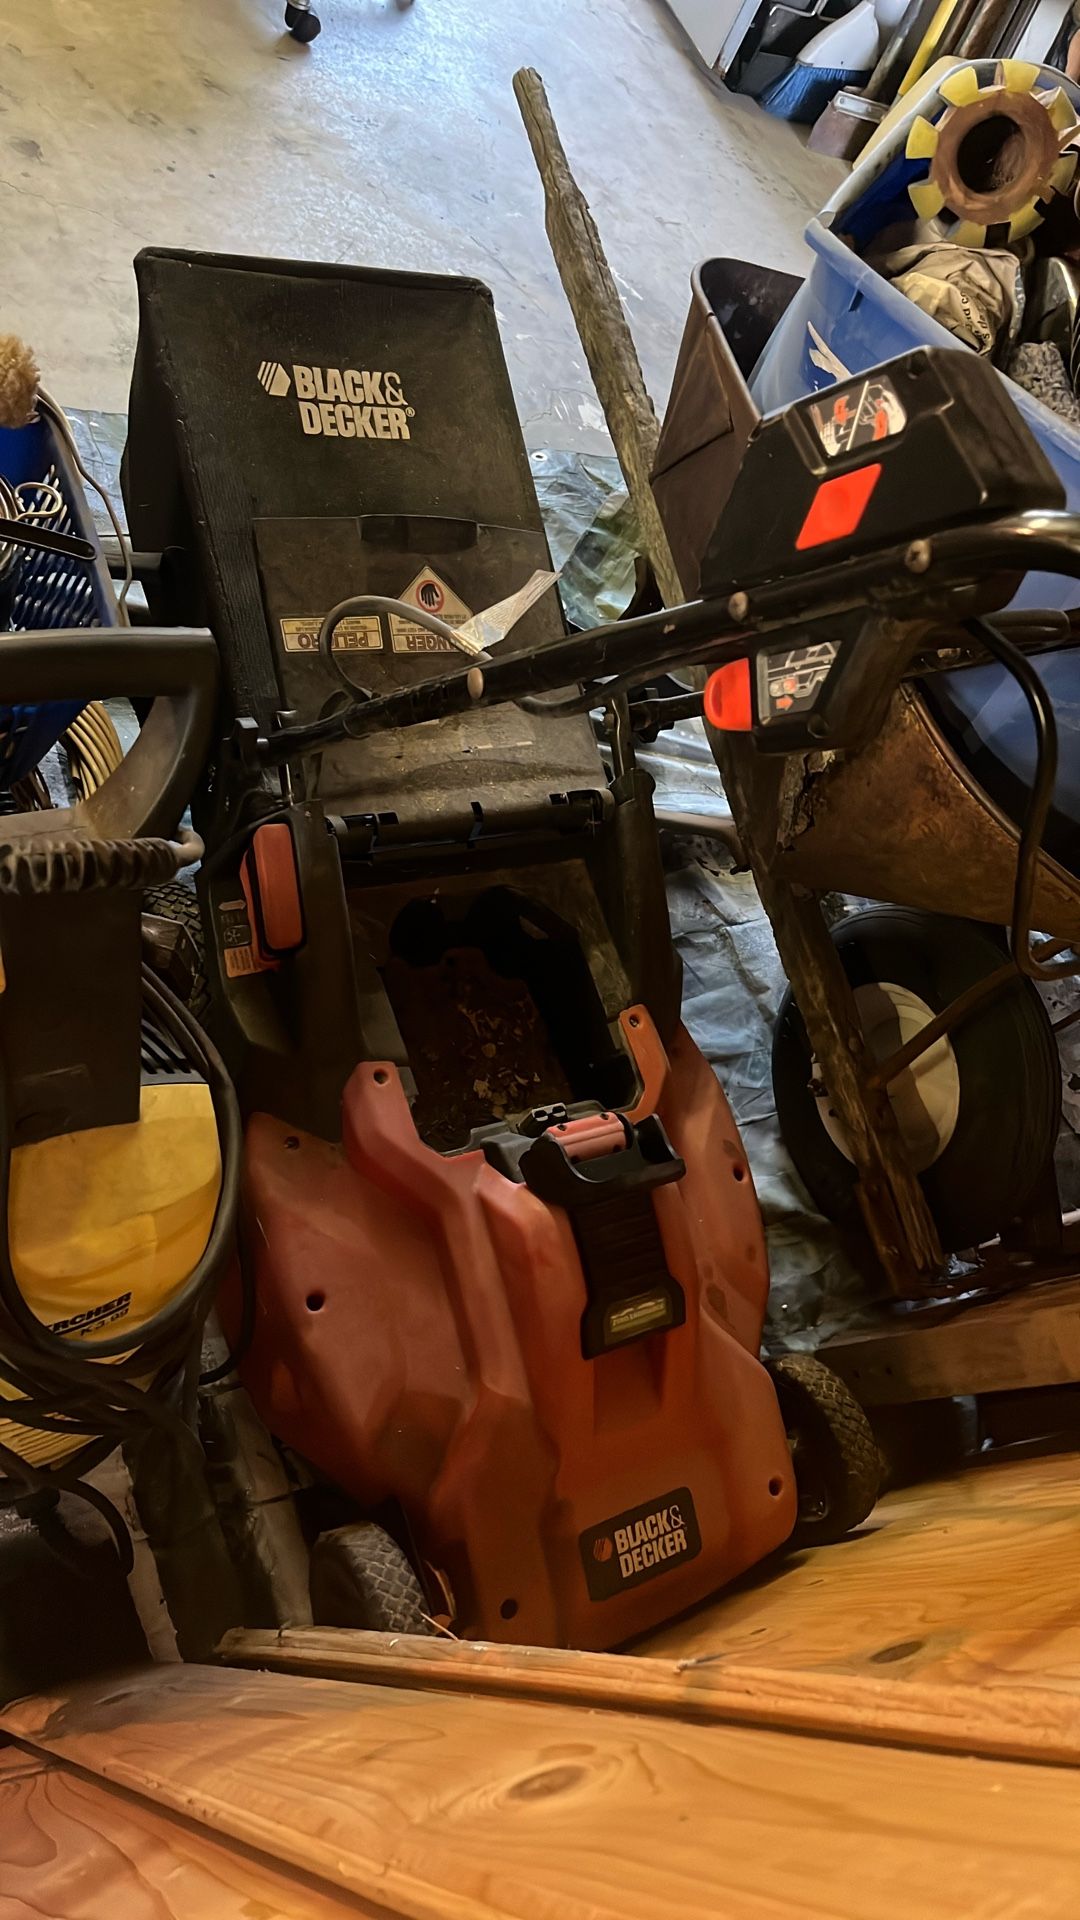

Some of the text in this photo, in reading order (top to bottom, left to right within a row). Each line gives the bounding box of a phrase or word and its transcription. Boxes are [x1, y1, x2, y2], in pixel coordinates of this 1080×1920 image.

[293, 365, 408, 406] BLACK&
[298, 632, 369, 649] PELIRO
[46, 1291, 132, 1332] RCHER
[614, 1505, 685, 1554] BLACK&
